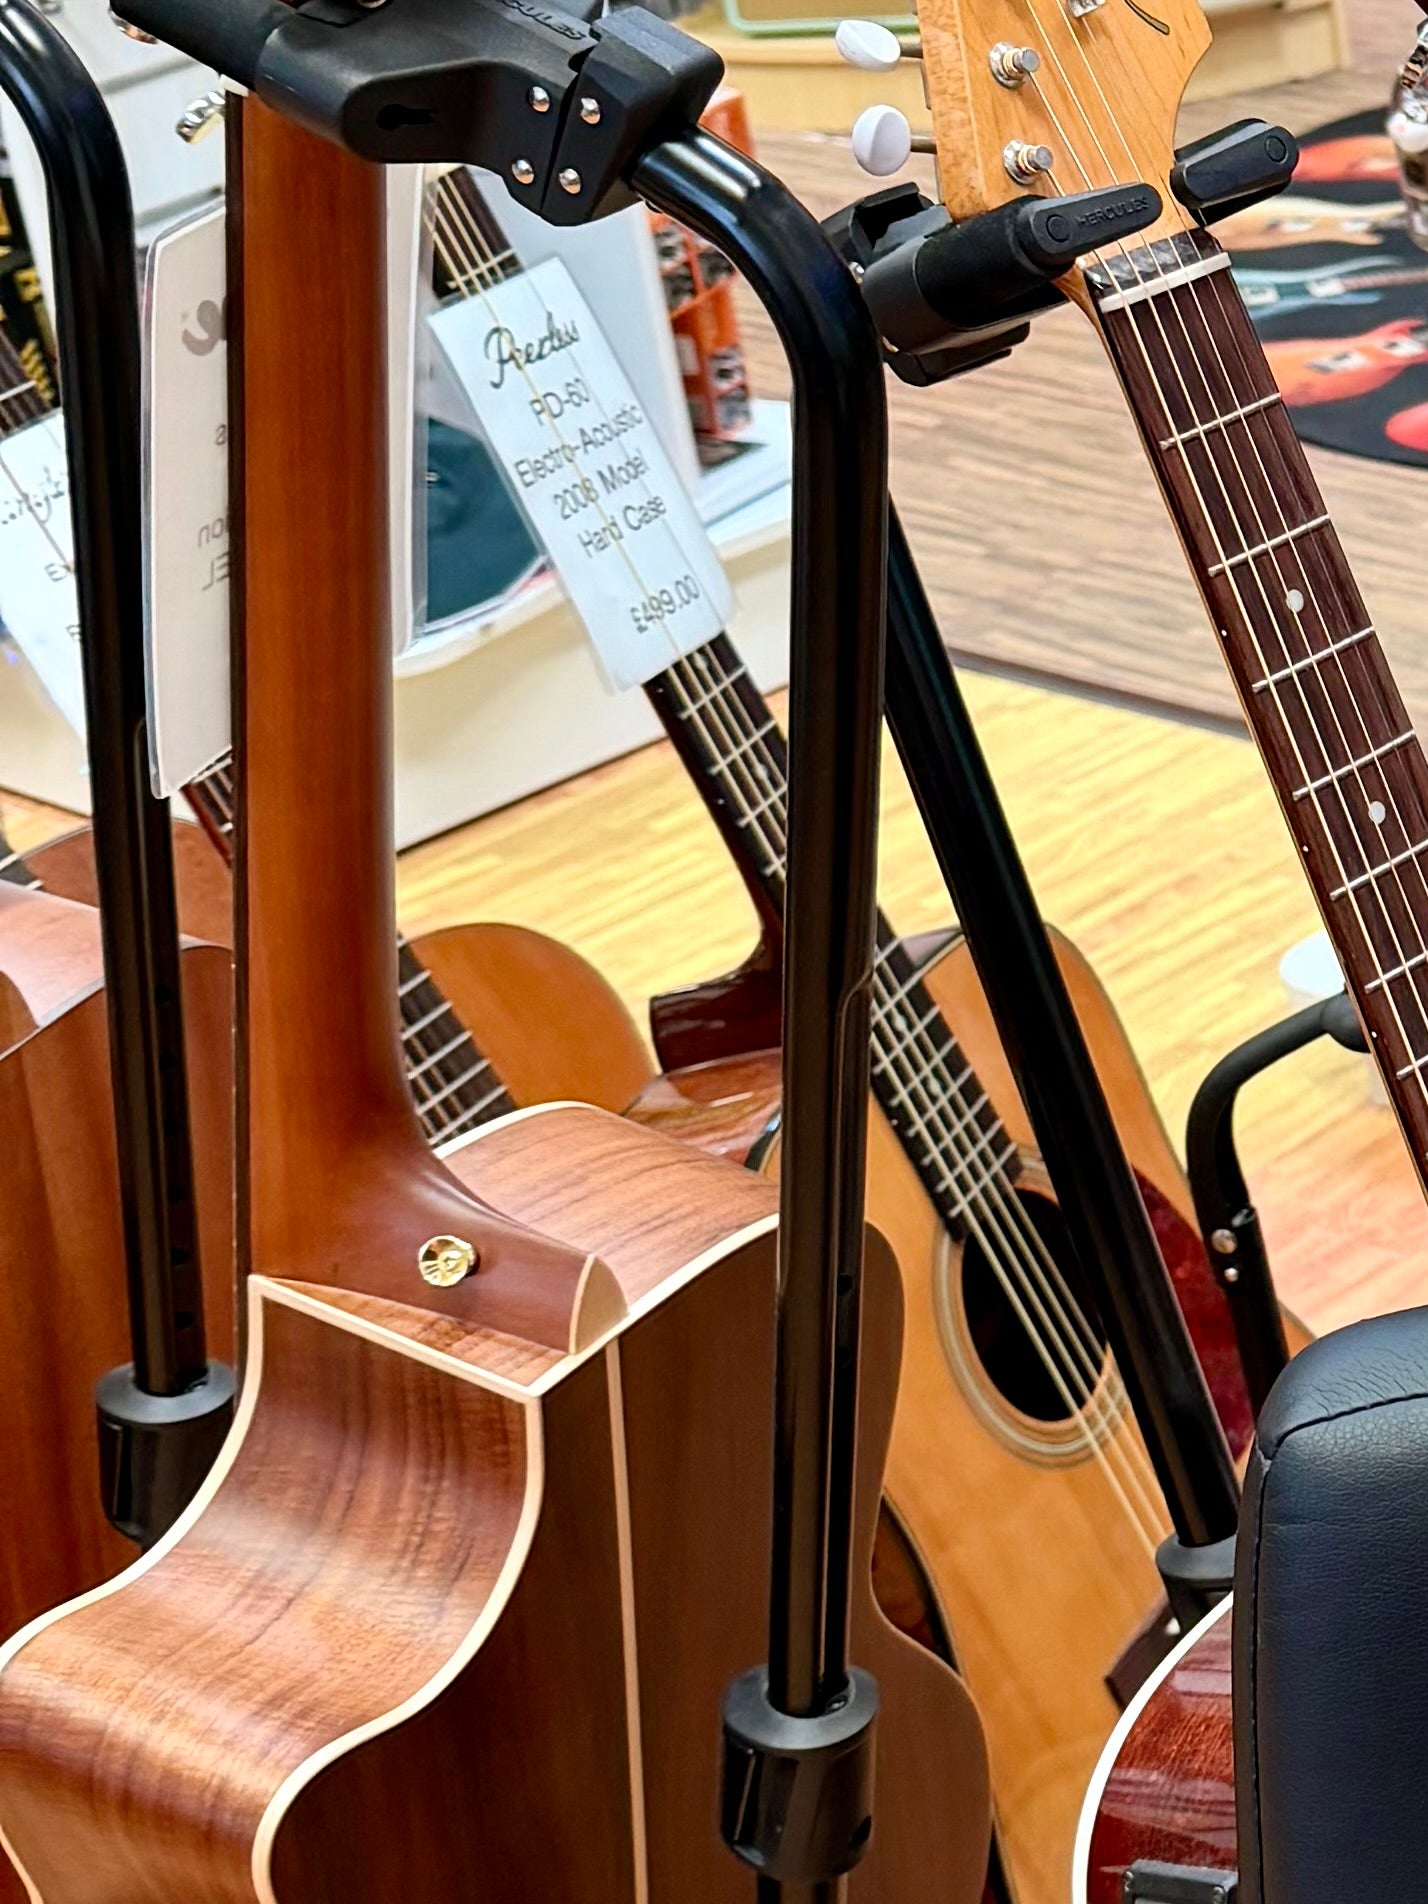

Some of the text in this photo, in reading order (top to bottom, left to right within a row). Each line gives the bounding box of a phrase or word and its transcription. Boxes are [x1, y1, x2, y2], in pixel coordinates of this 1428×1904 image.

[1076, 196, 1149, 227] HERCULES
[484, 310, 581, 390] Peerless
[528, 376, 592, 428] PD-60
[513, 402, 646, 489] Electro-Acoustic
[553, 448, 652, 521] 2008 Model
[622, 493, 669, 533] Case
[629, 574, 702, 635] £499.00
